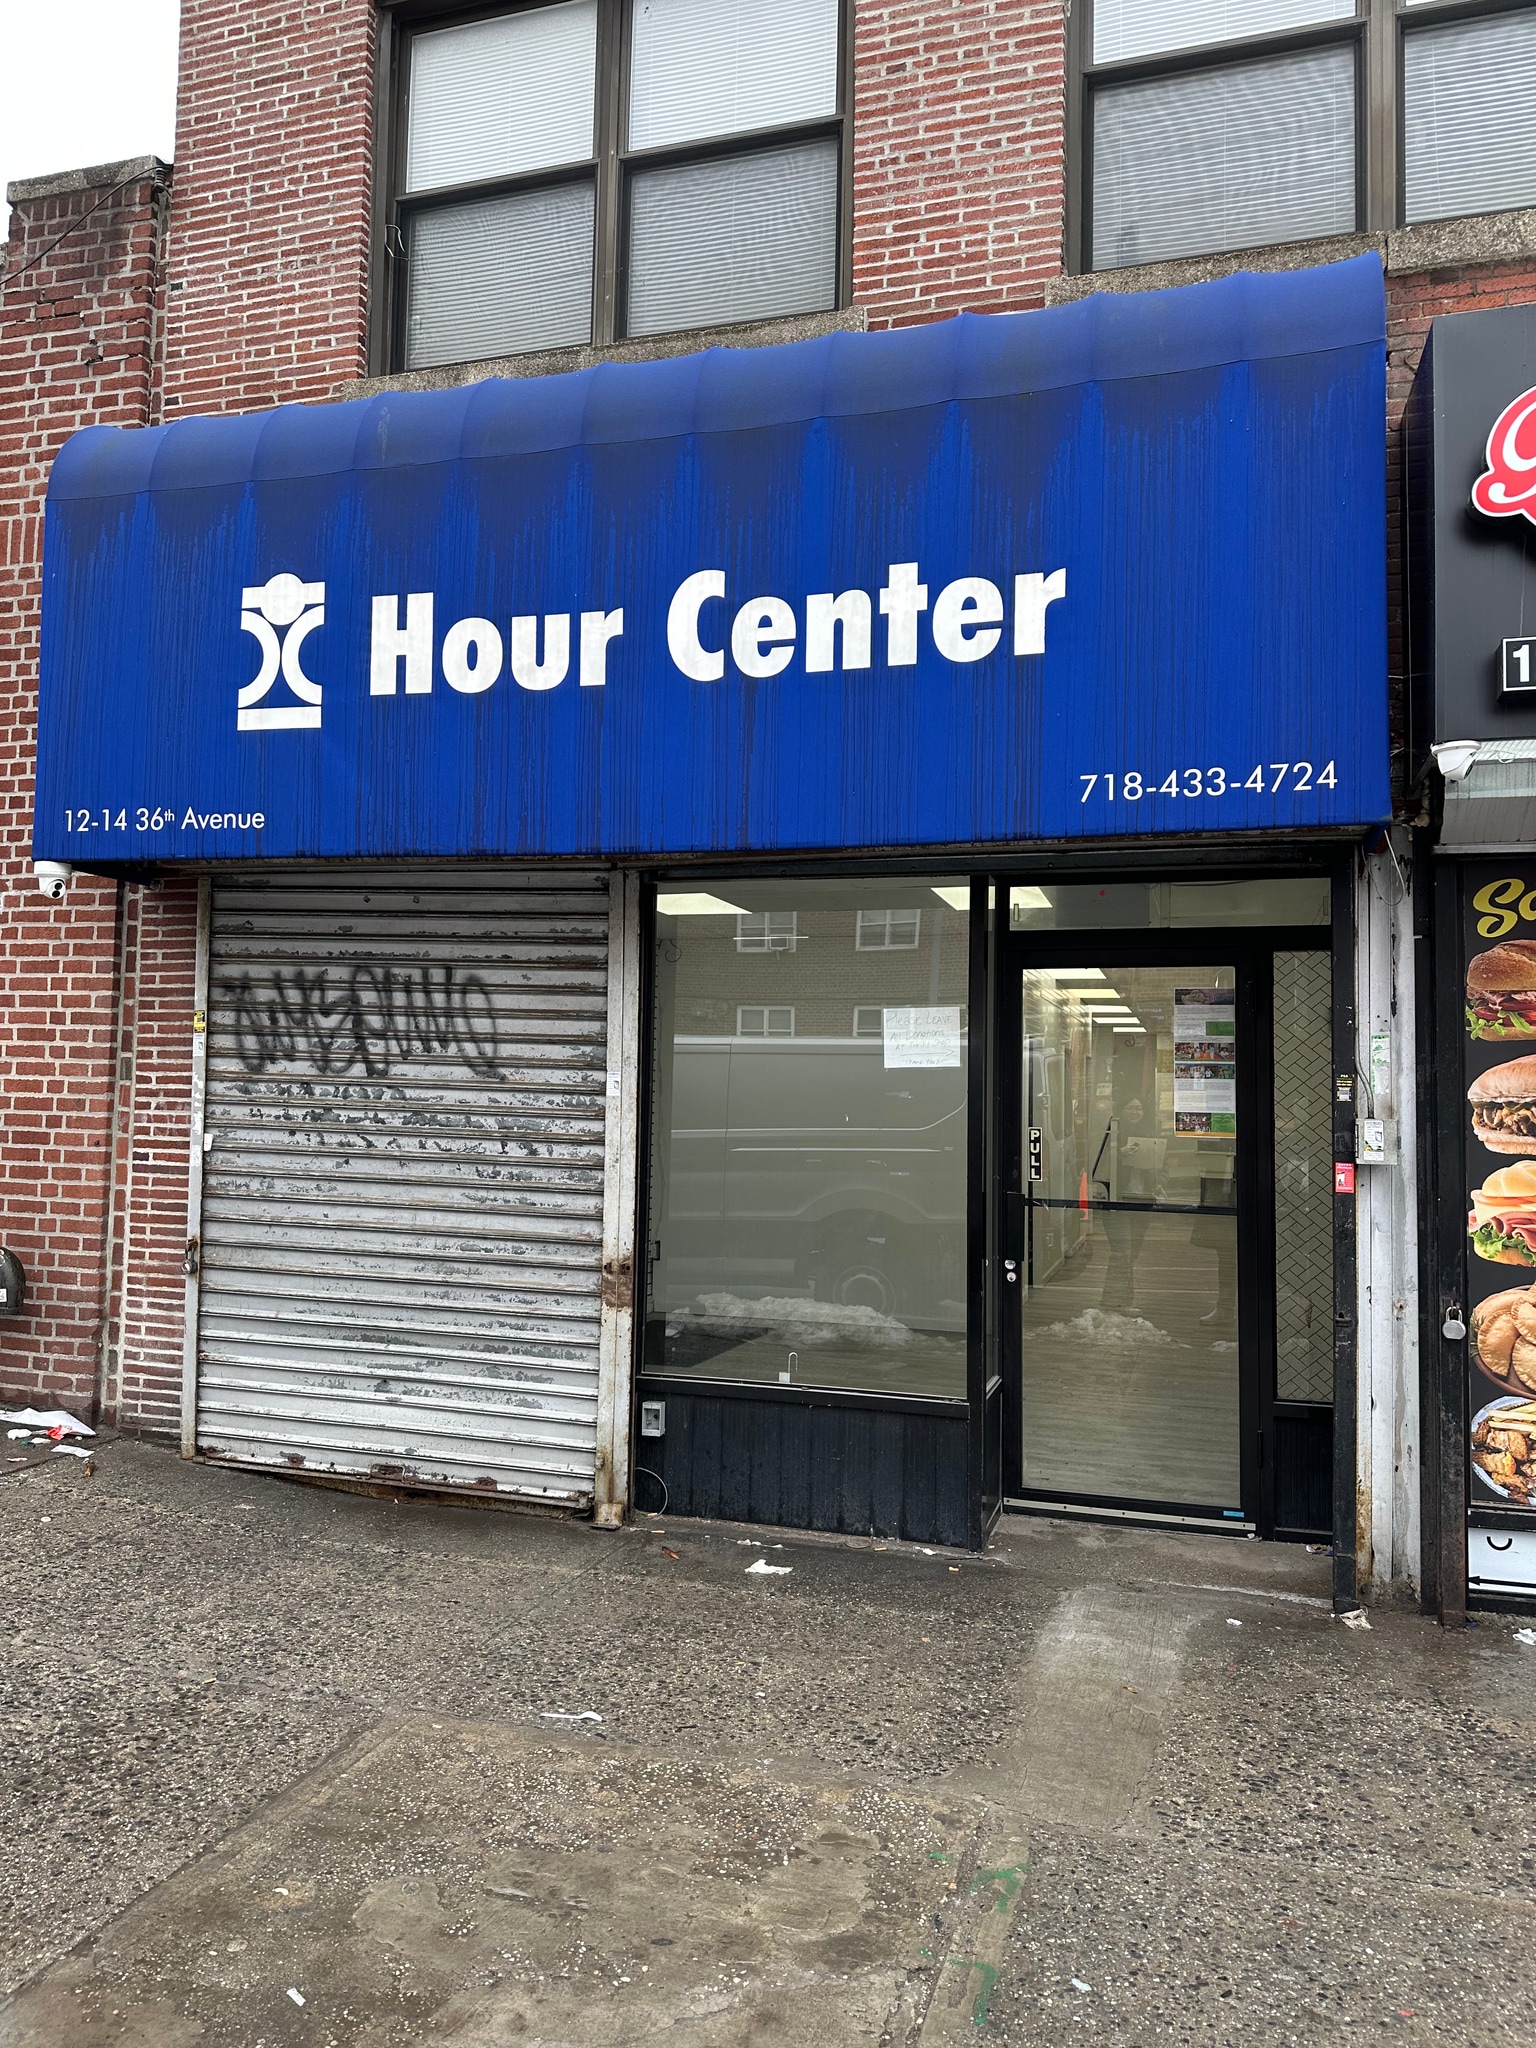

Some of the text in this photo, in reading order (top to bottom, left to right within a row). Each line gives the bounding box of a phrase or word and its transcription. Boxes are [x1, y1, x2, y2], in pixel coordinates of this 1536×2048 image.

[370, 561, 1067, 696] Hour Center
[1079, 760, 1338, 803] 718-433-4724
[65, 808, 127, 832] 12-14
[181, 806, 265, 830] Avenue
[1029, 1129, 1041, 1180] PULL
